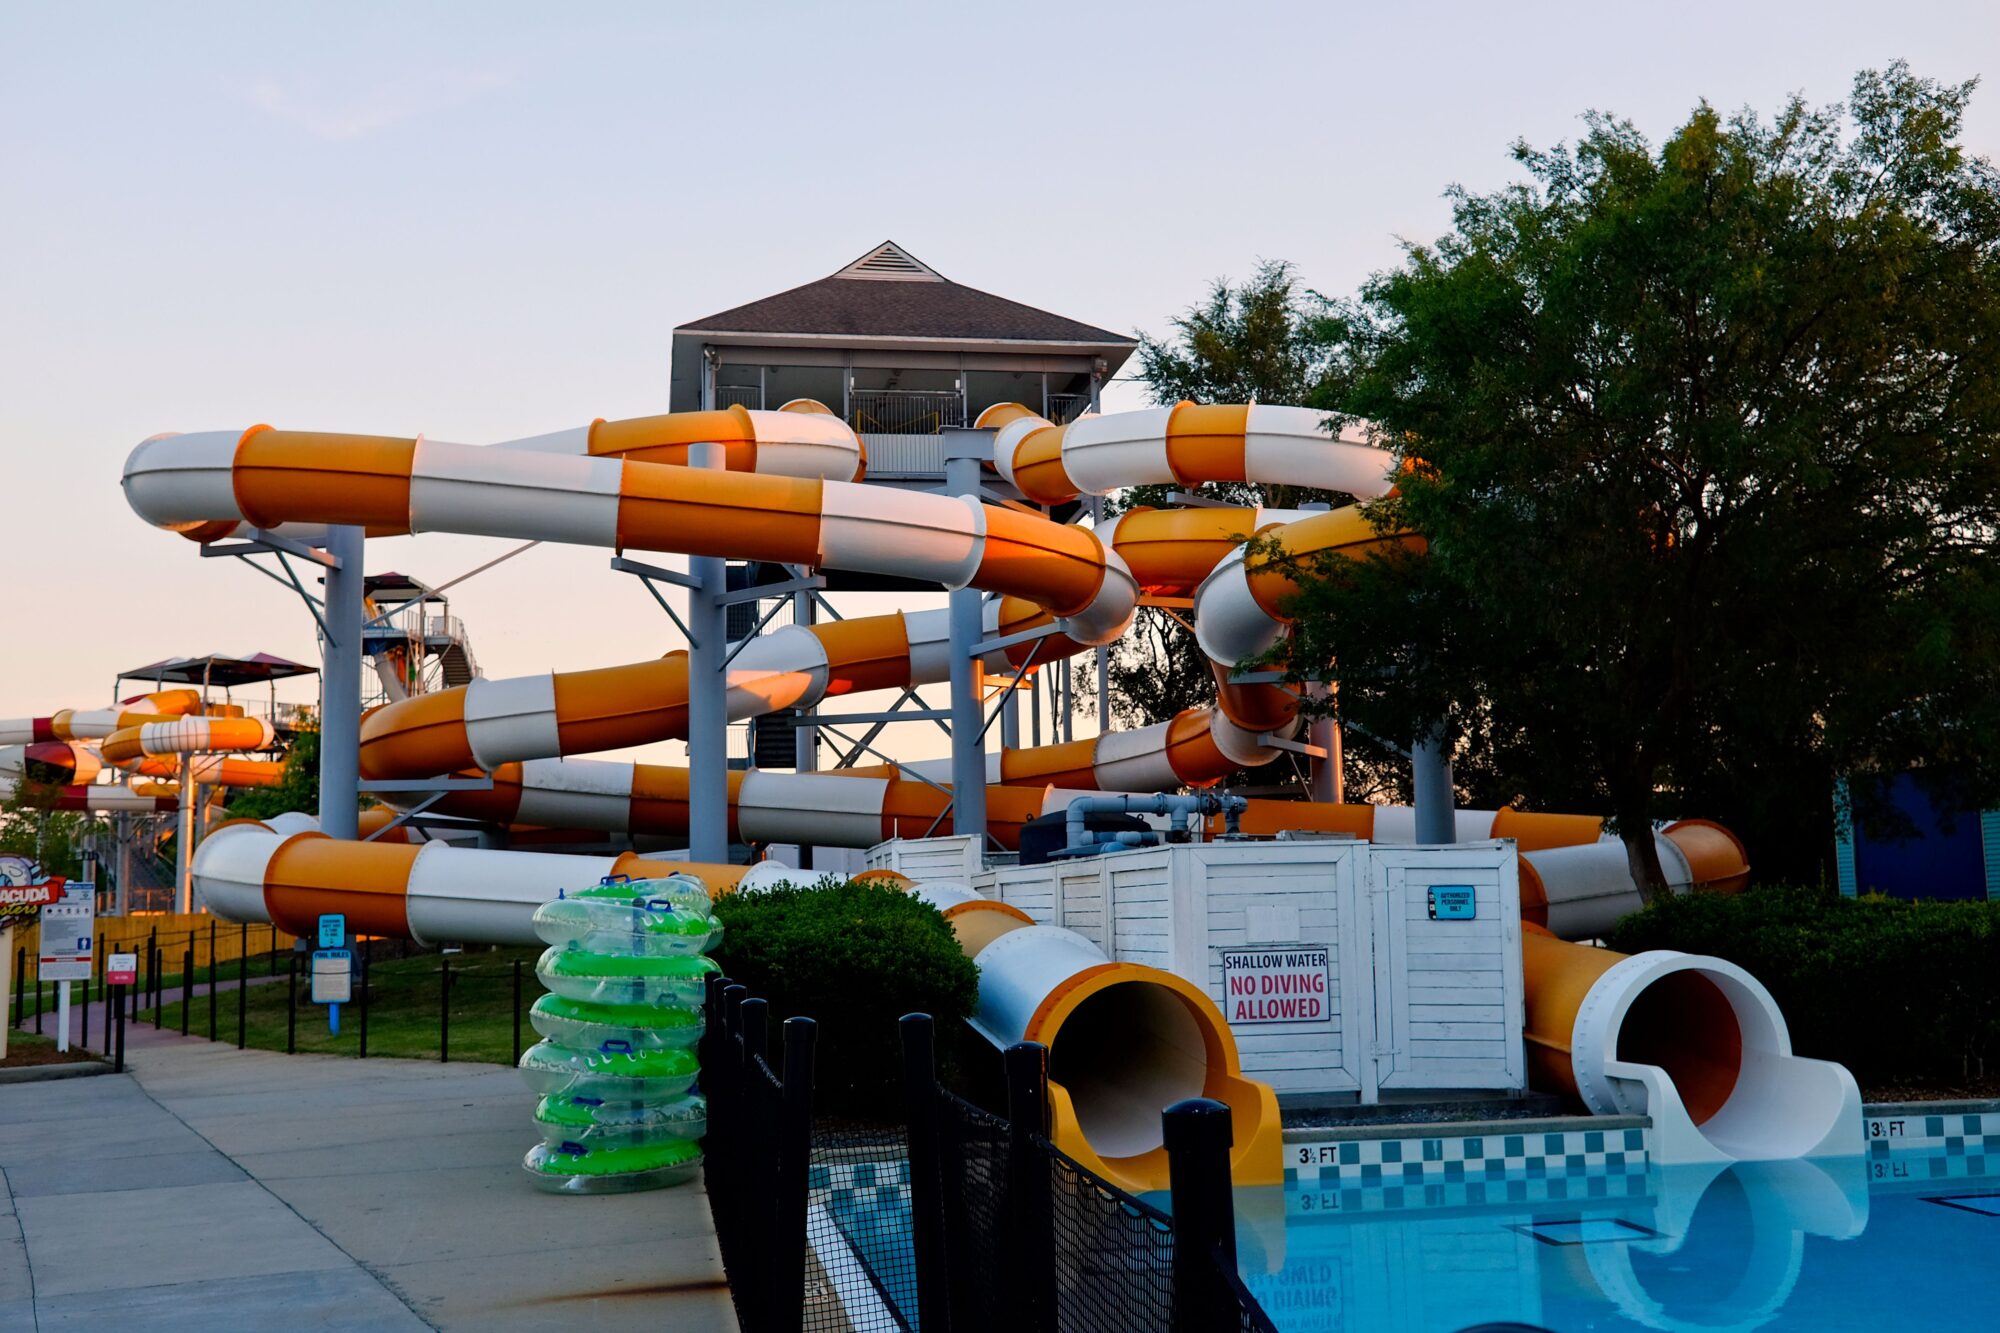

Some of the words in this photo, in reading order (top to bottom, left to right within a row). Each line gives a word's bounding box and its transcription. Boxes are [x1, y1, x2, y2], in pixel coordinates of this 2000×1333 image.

[1226, 955, 1283, 969] SHALLOW
[1286, 954, 1326, 968] WATER
[1231, 975, 1256, 996] NO
[1261, 973, 1324, 995] DIVING
[1235, 998, 1321, 1020] ALLOWED
[1889, 1121, 1905, 1137] FT
[1319, 1146, 1337, 1163] FT
